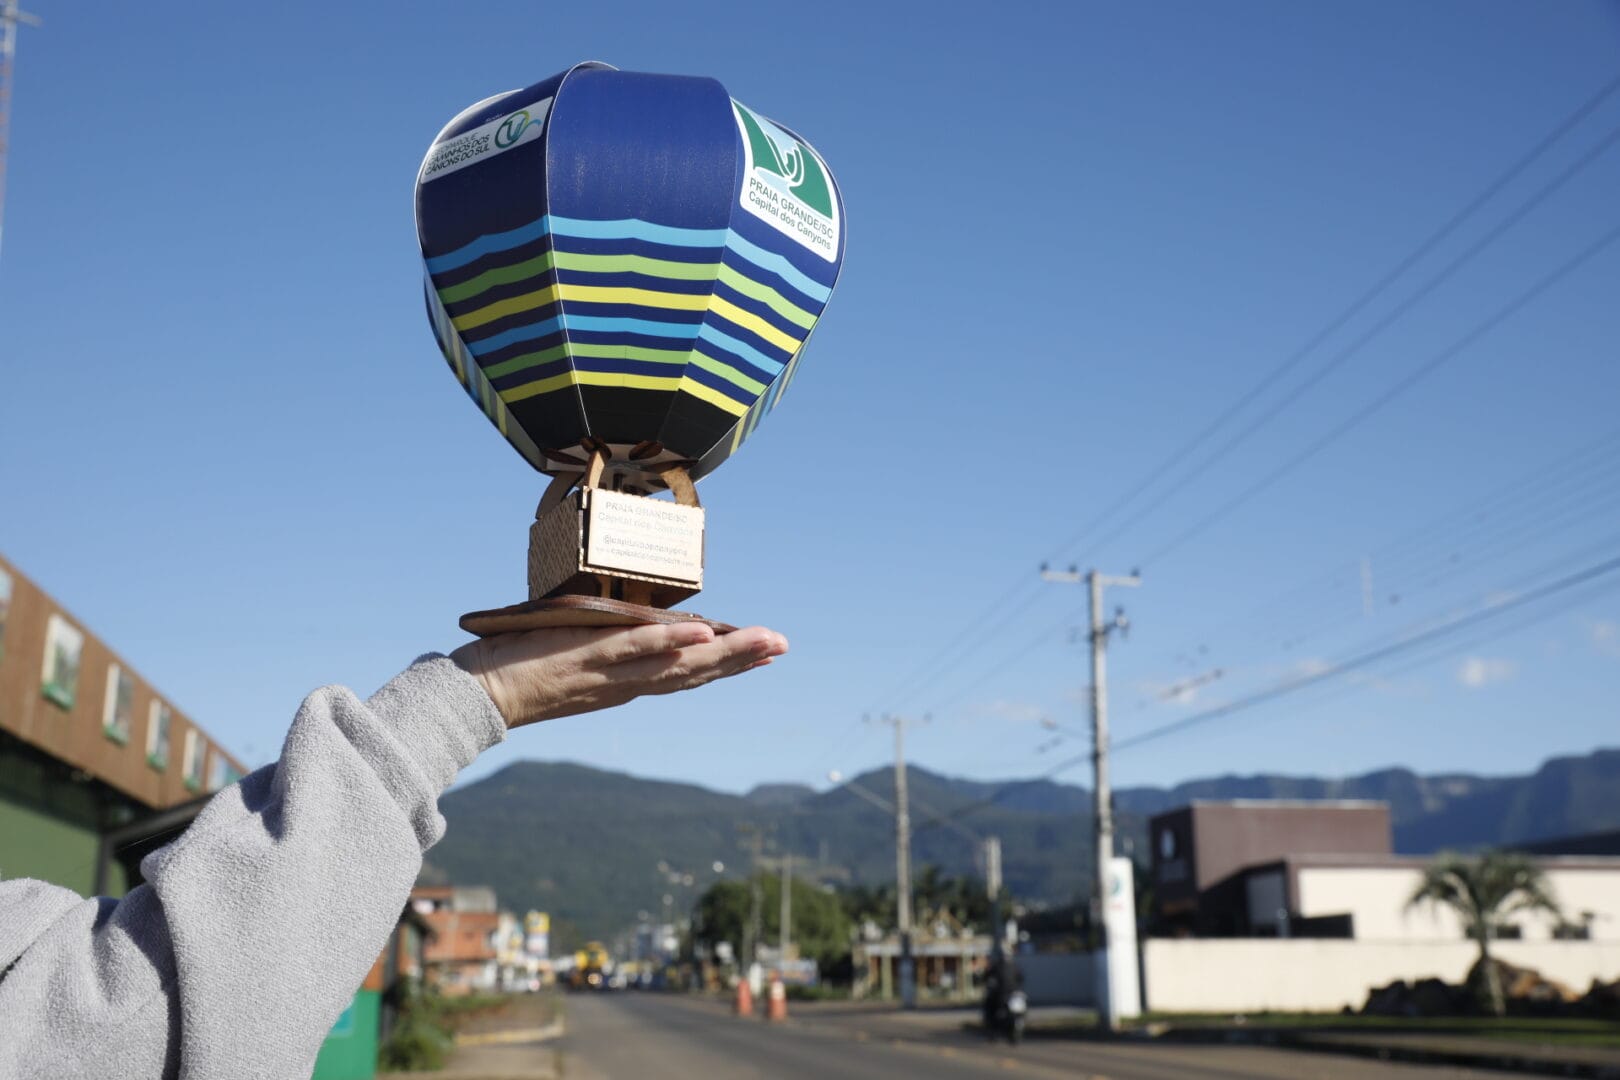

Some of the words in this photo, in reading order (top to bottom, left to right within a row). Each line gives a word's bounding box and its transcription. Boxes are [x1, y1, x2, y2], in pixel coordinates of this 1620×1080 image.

[474, 143, 490, 156] SUL
[749, 177, 779, 204] PRAIA
[780, 198, 834, 239] GRANDE/SC
[749, 191, 779, 217] Capital
[780, 211, 795, 227] dos
[797, 221, 832, 250] Canyons
